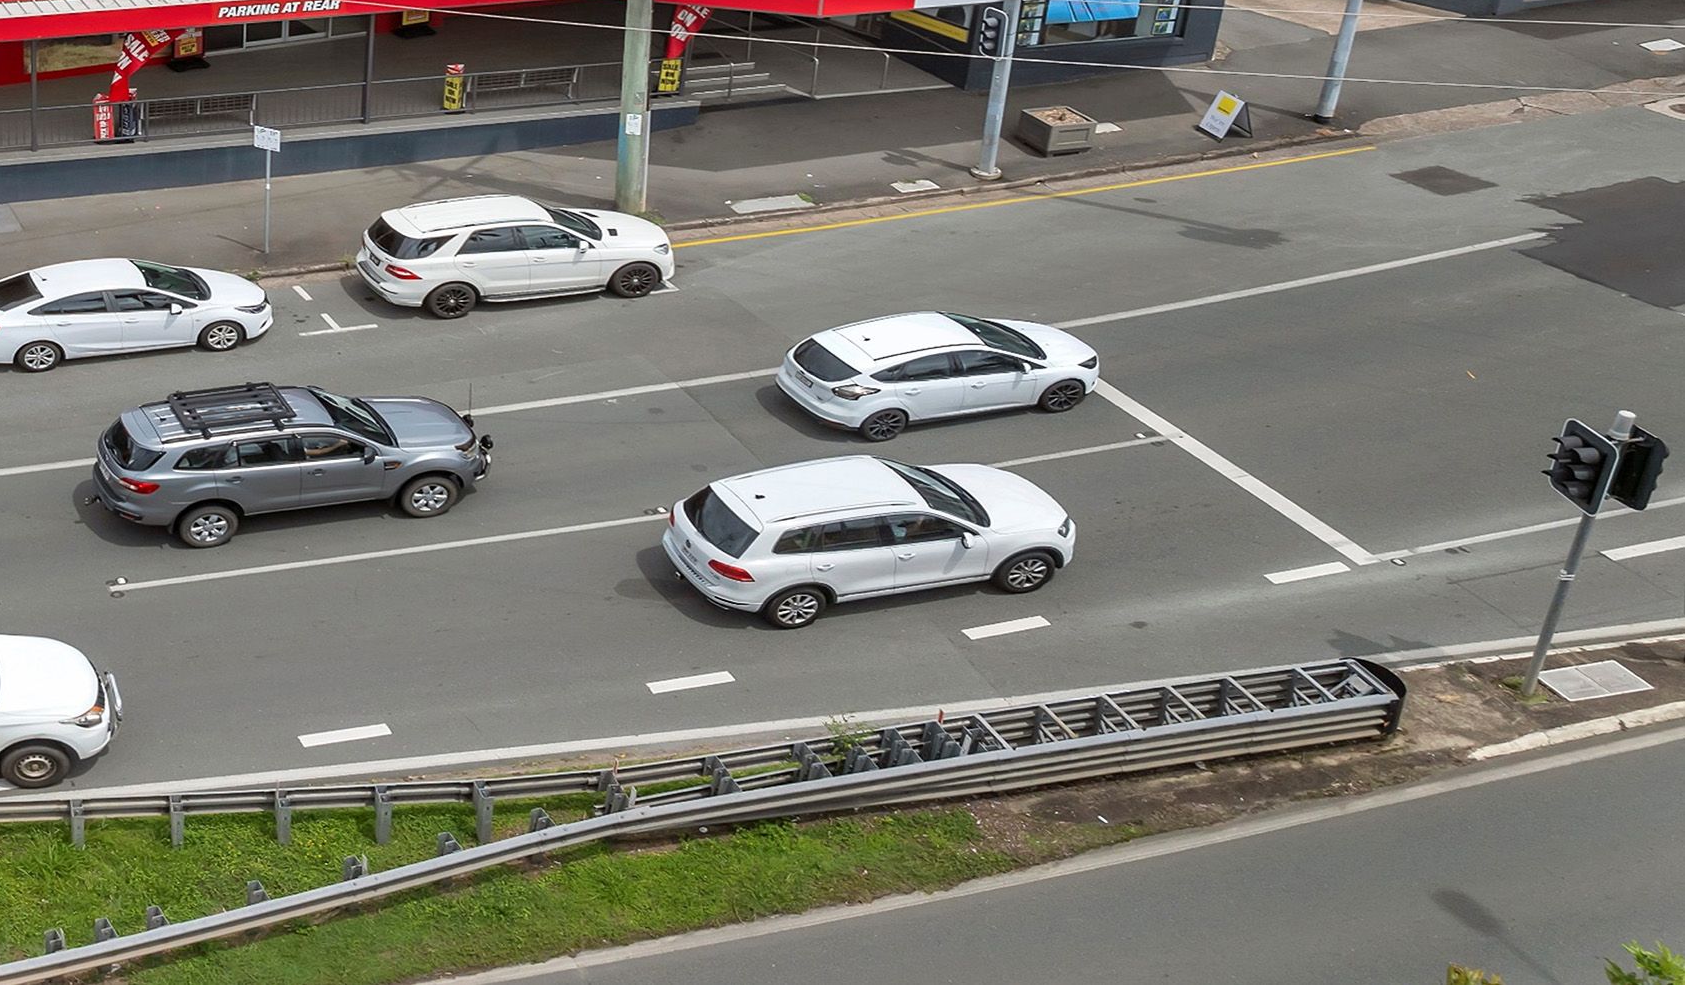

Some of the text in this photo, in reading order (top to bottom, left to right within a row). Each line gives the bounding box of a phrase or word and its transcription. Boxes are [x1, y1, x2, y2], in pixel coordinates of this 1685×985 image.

[217, 3, 280, 18] PARKING
[281, 1, 303, 14] AT
[677, 9, 697, 27] ON
[124, 33, 150, 62] SALE
